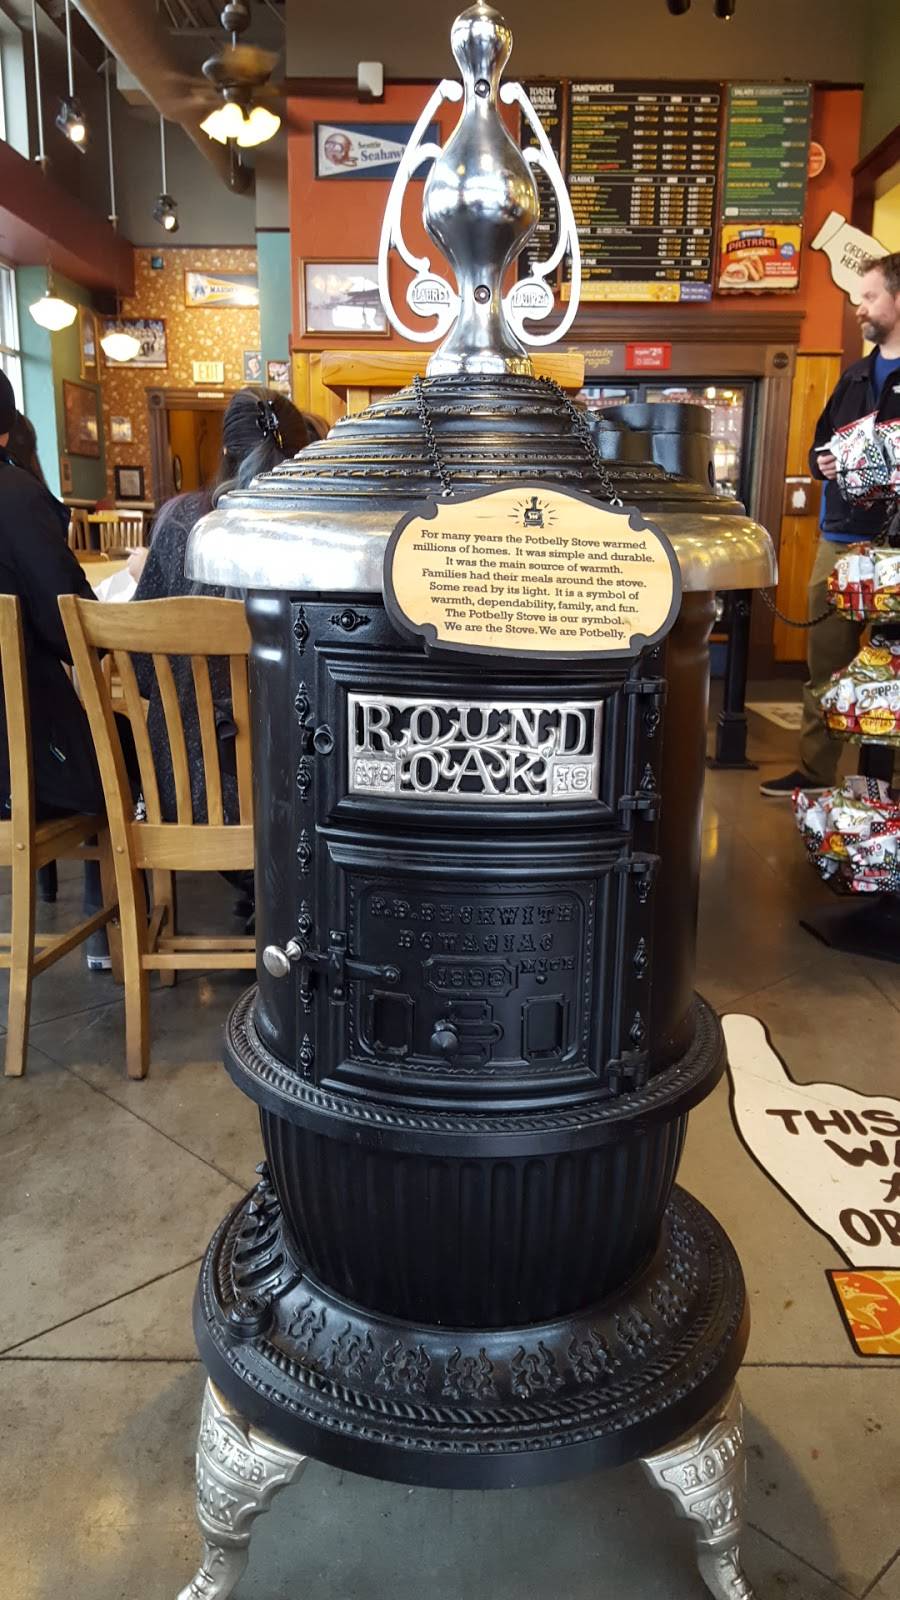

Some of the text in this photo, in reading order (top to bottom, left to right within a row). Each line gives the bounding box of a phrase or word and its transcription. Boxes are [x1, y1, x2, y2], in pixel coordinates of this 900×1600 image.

[529, 87, 556, 96] TOASTY
[571, 84, 614, 92] SANDWICHES
[728, 238, 775, 251] PASTRAMI
[421, 529, 647, 549] For many years the Potbelly Stove warmed
[413, 542, 655, 562] millions of homes. It was simple and durable.
[446, 557, 624, 574] It was the main source of warmth.
[422, 568, 647, 588] Families had their meals around the stove.
[430, 581, 460, 591] Some
[463, 583, 488, 593] read
[491, 584, 504, 596] by
[507, 585, 520, 594] its
[523, 586, 550, 598] light.
[556, 587, 562, 596] It
[565, 588, 574, 597] is
[586, 589, 626, 602] symbol
[629, 591, 640, 600] of
[431, 594, 639, 613] warmth, dependability, family, and fun.
[445, 608, 625, 627] The Potbelly Stove is our symbol.
[444, 621, 626, 640] We are the Stove. We are Potbelly.
[362, 701, 587, 756] ROUND
[410, 748, 545, 795] OAK
[556, 766, 589, 791] 18
[765, 1109, 900, 1137] THIS
